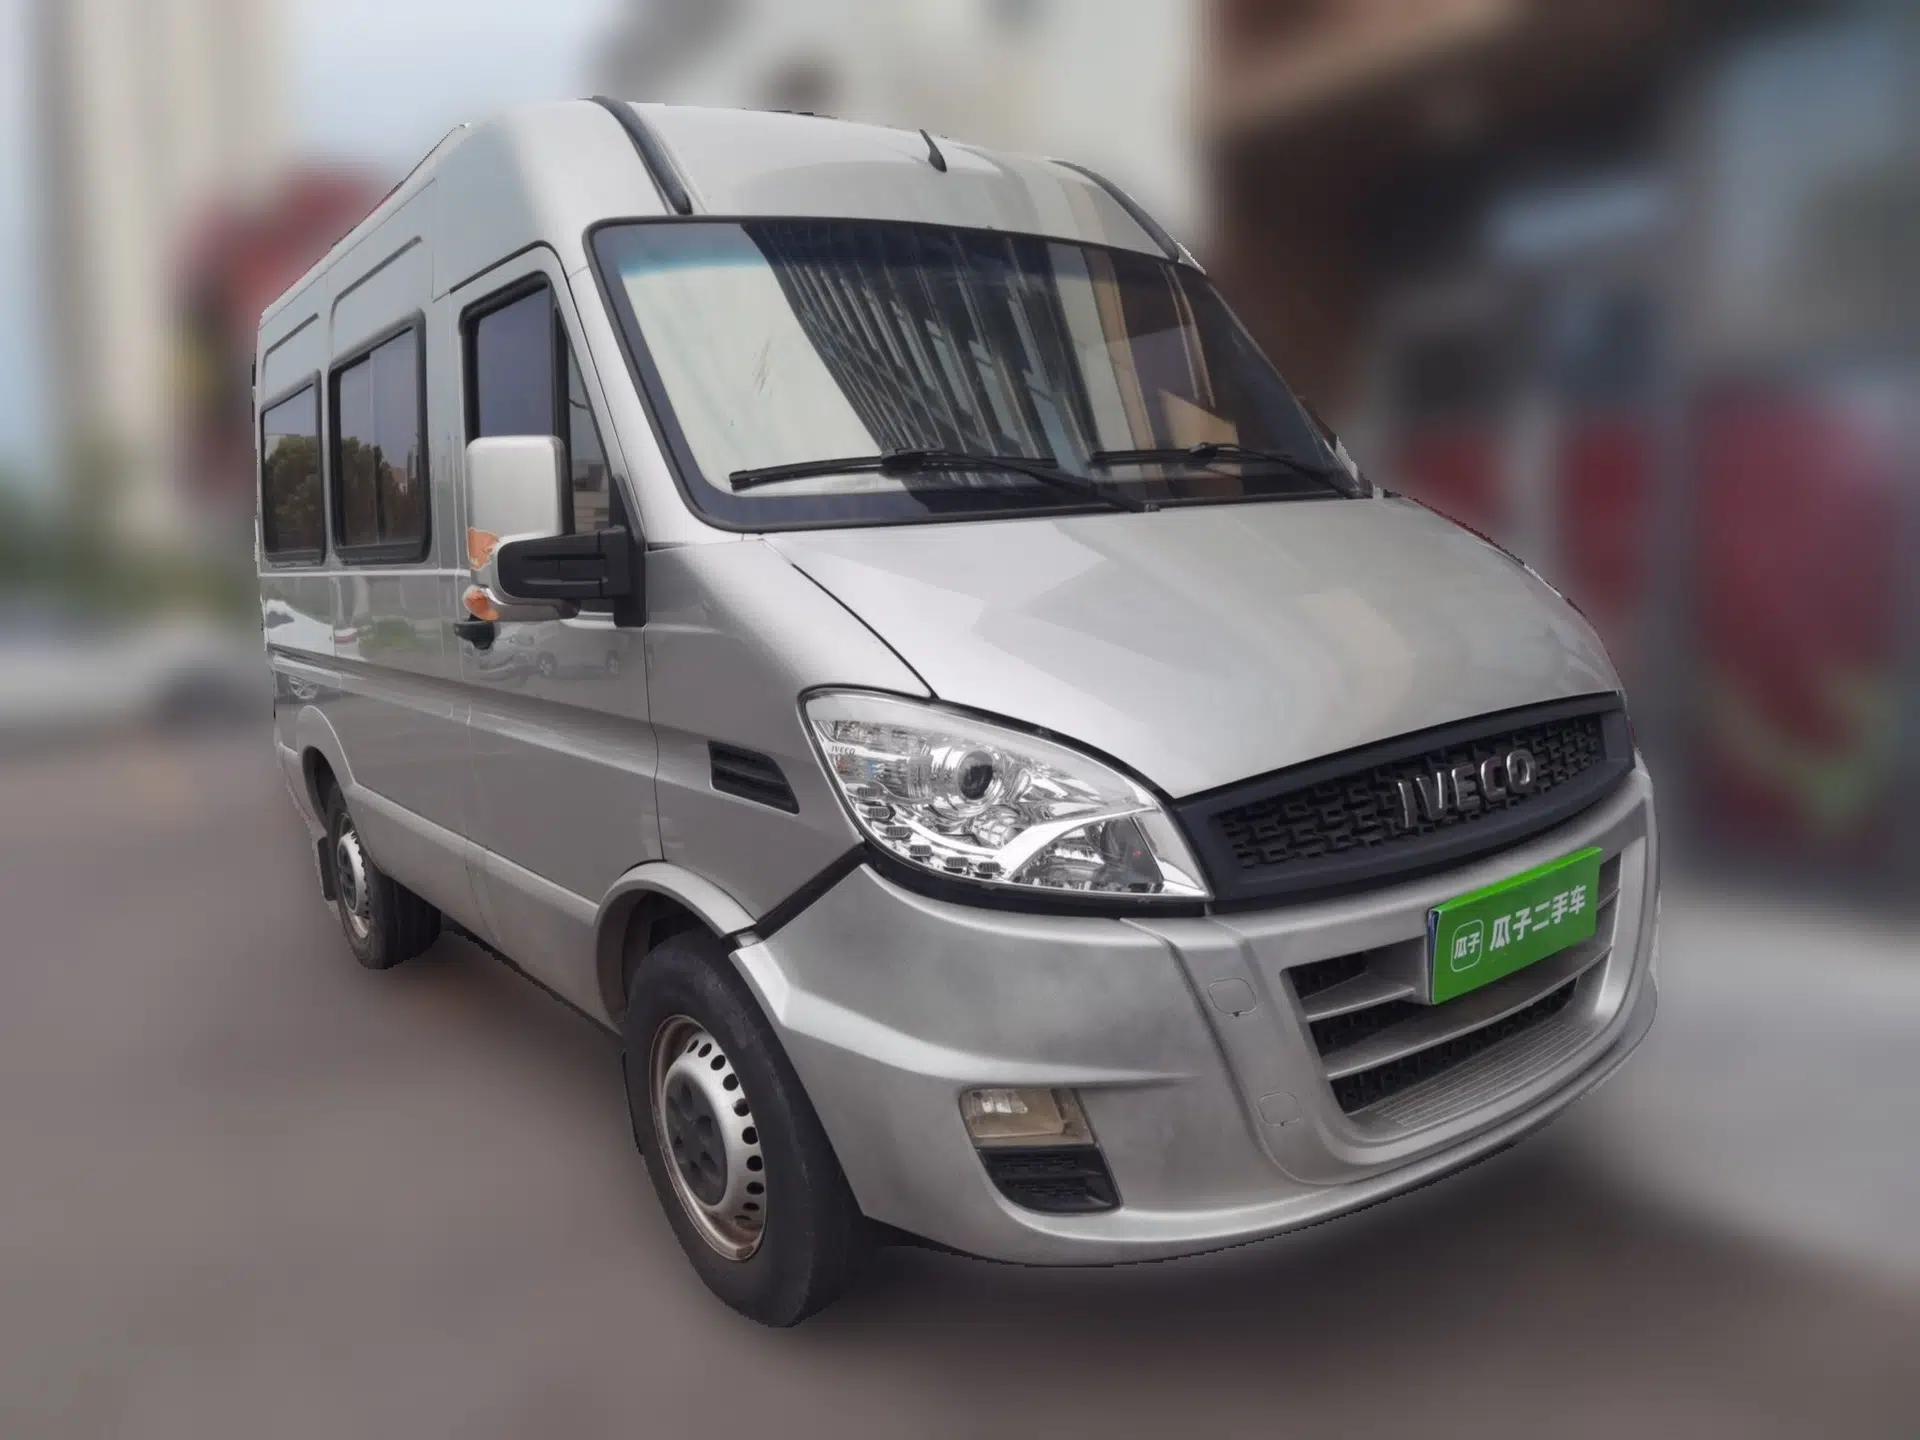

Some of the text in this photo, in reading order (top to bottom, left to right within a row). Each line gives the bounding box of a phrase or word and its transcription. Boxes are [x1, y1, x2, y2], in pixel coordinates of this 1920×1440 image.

[831, 744, 856, 756] IVECO
[1397, 749, 1537, 829] IVECO
[1490, 885, 1587, 951] 瓜子二手车
[1454, 931, 1481, 960] 瓜子
